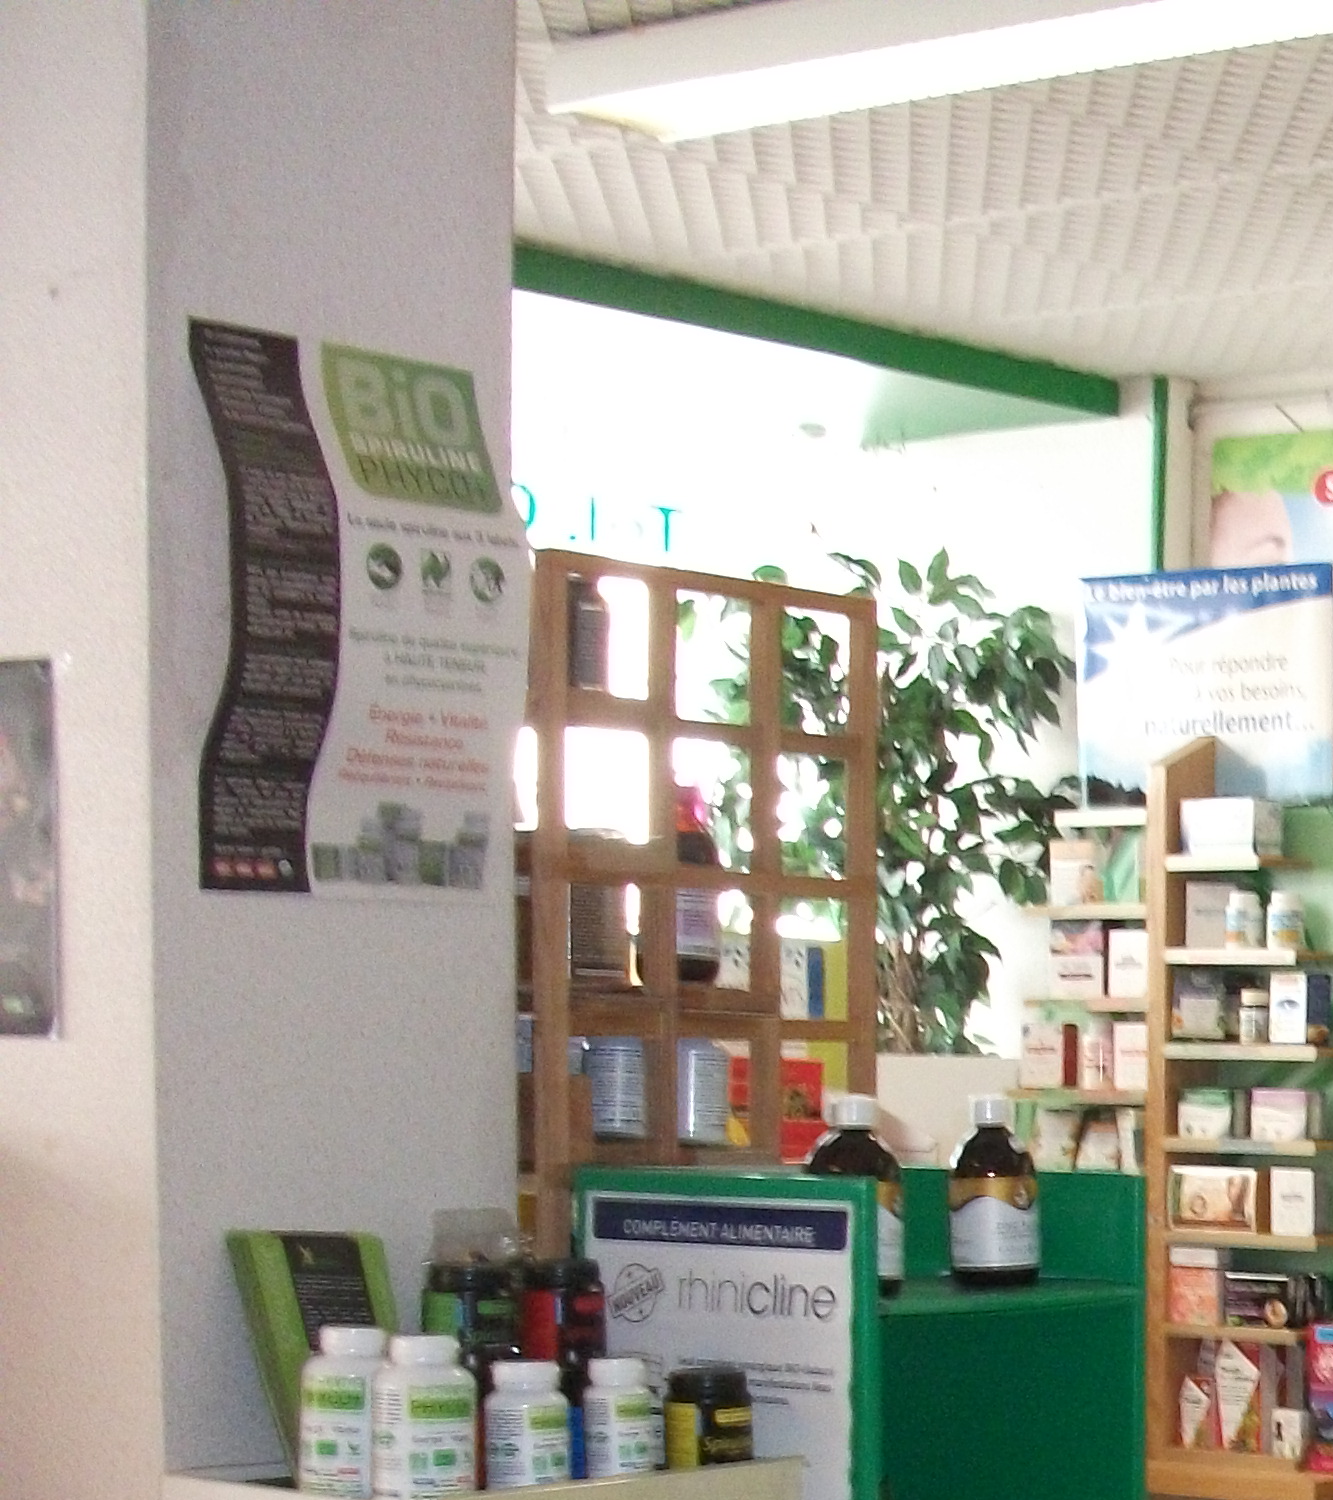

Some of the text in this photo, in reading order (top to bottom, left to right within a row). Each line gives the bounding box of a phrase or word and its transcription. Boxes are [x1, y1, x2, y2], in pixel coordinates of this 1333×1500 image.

[1222, 572, 1250, 595] les
[1251, 570, 1318, 598] plantes
[622, 1216, 817, 1244] COMPLÉMENT ALIMENTAIRE
[677, 1269, 838, 1320] rhinicline
